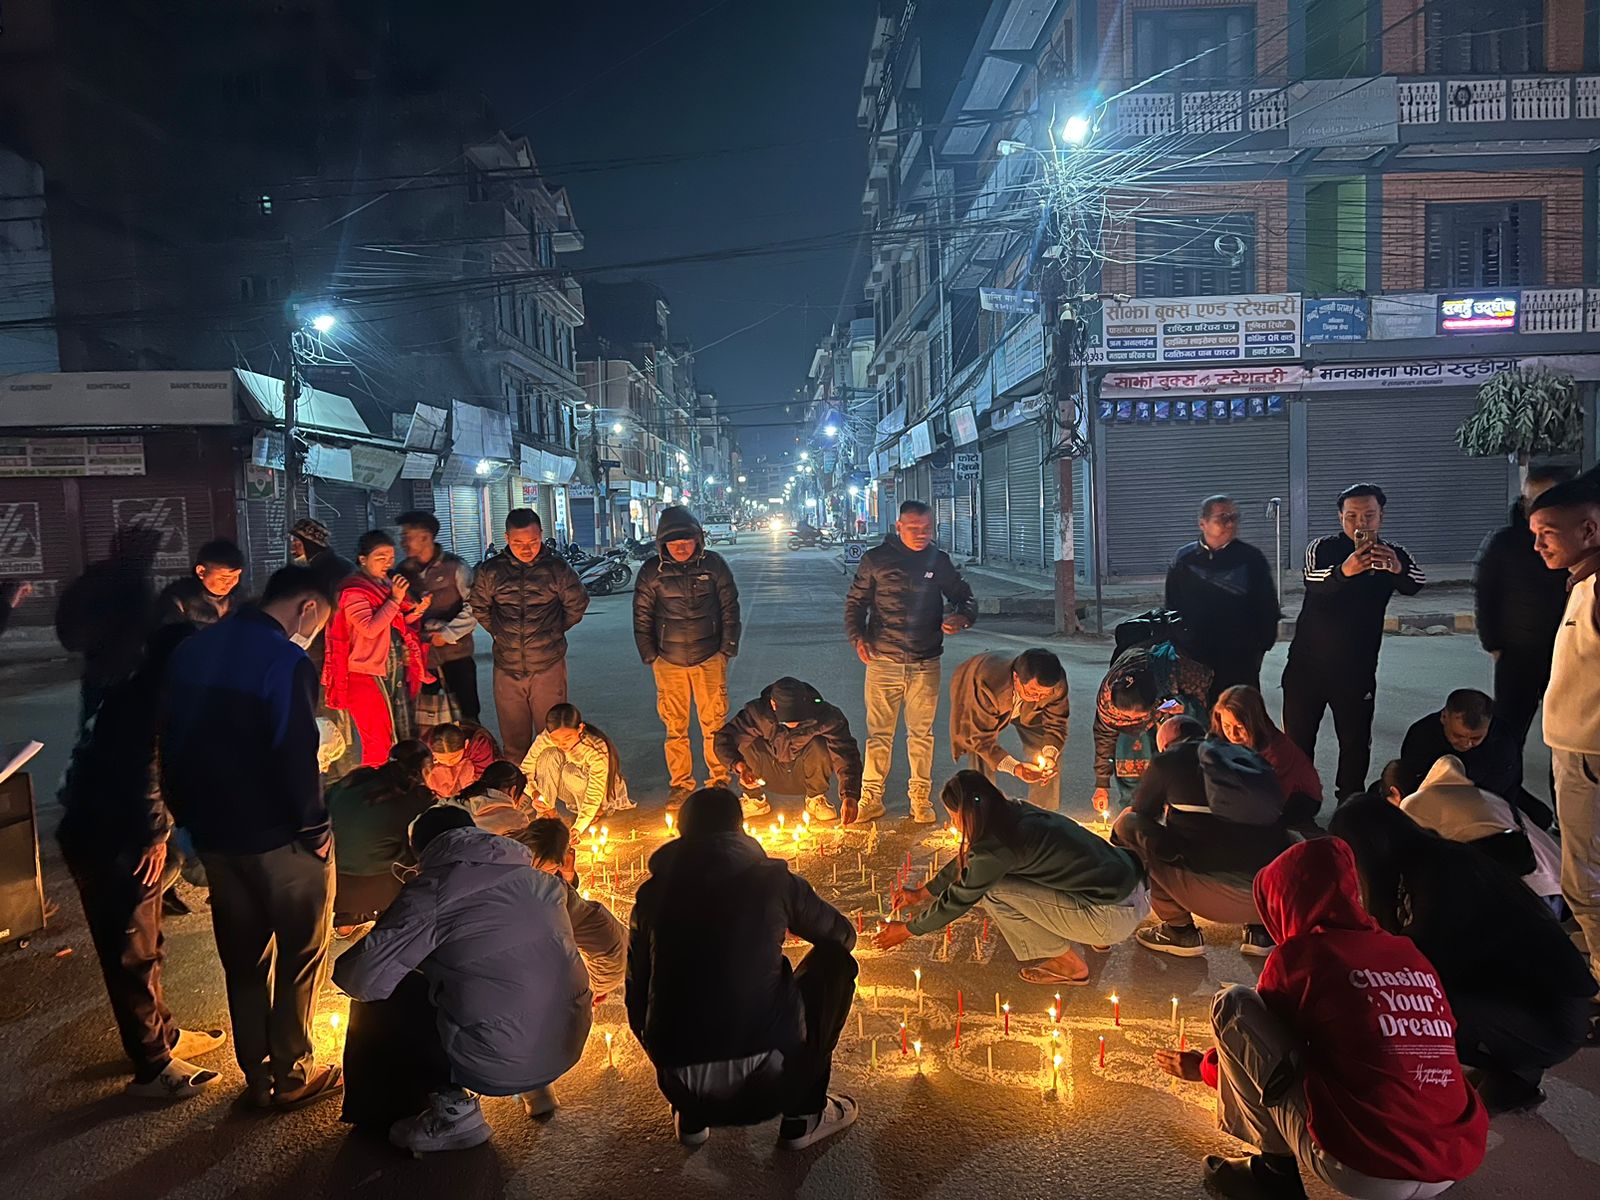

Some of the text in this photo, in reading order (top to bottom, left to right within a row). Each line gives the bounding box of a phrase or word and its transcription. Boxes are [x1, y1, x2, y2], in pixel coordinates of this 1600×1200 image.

[1155, 303, 1190, 322] बुक्स
[1233, 296, 1297, 316] स्टेशनरी
[1157, 374, 1198, 391] बुक्स
[1214, 368, 1288, 385] स्टेशनरी
[1319, 365, 1399, 381] मनकामना
[1401, 361, 1442, 377] फोटो
[1348, 967, 1443, 999] Chasing
[1379, 989, 1435, 1012] Your
[1377, 1013, 1453, 1038] Dream
